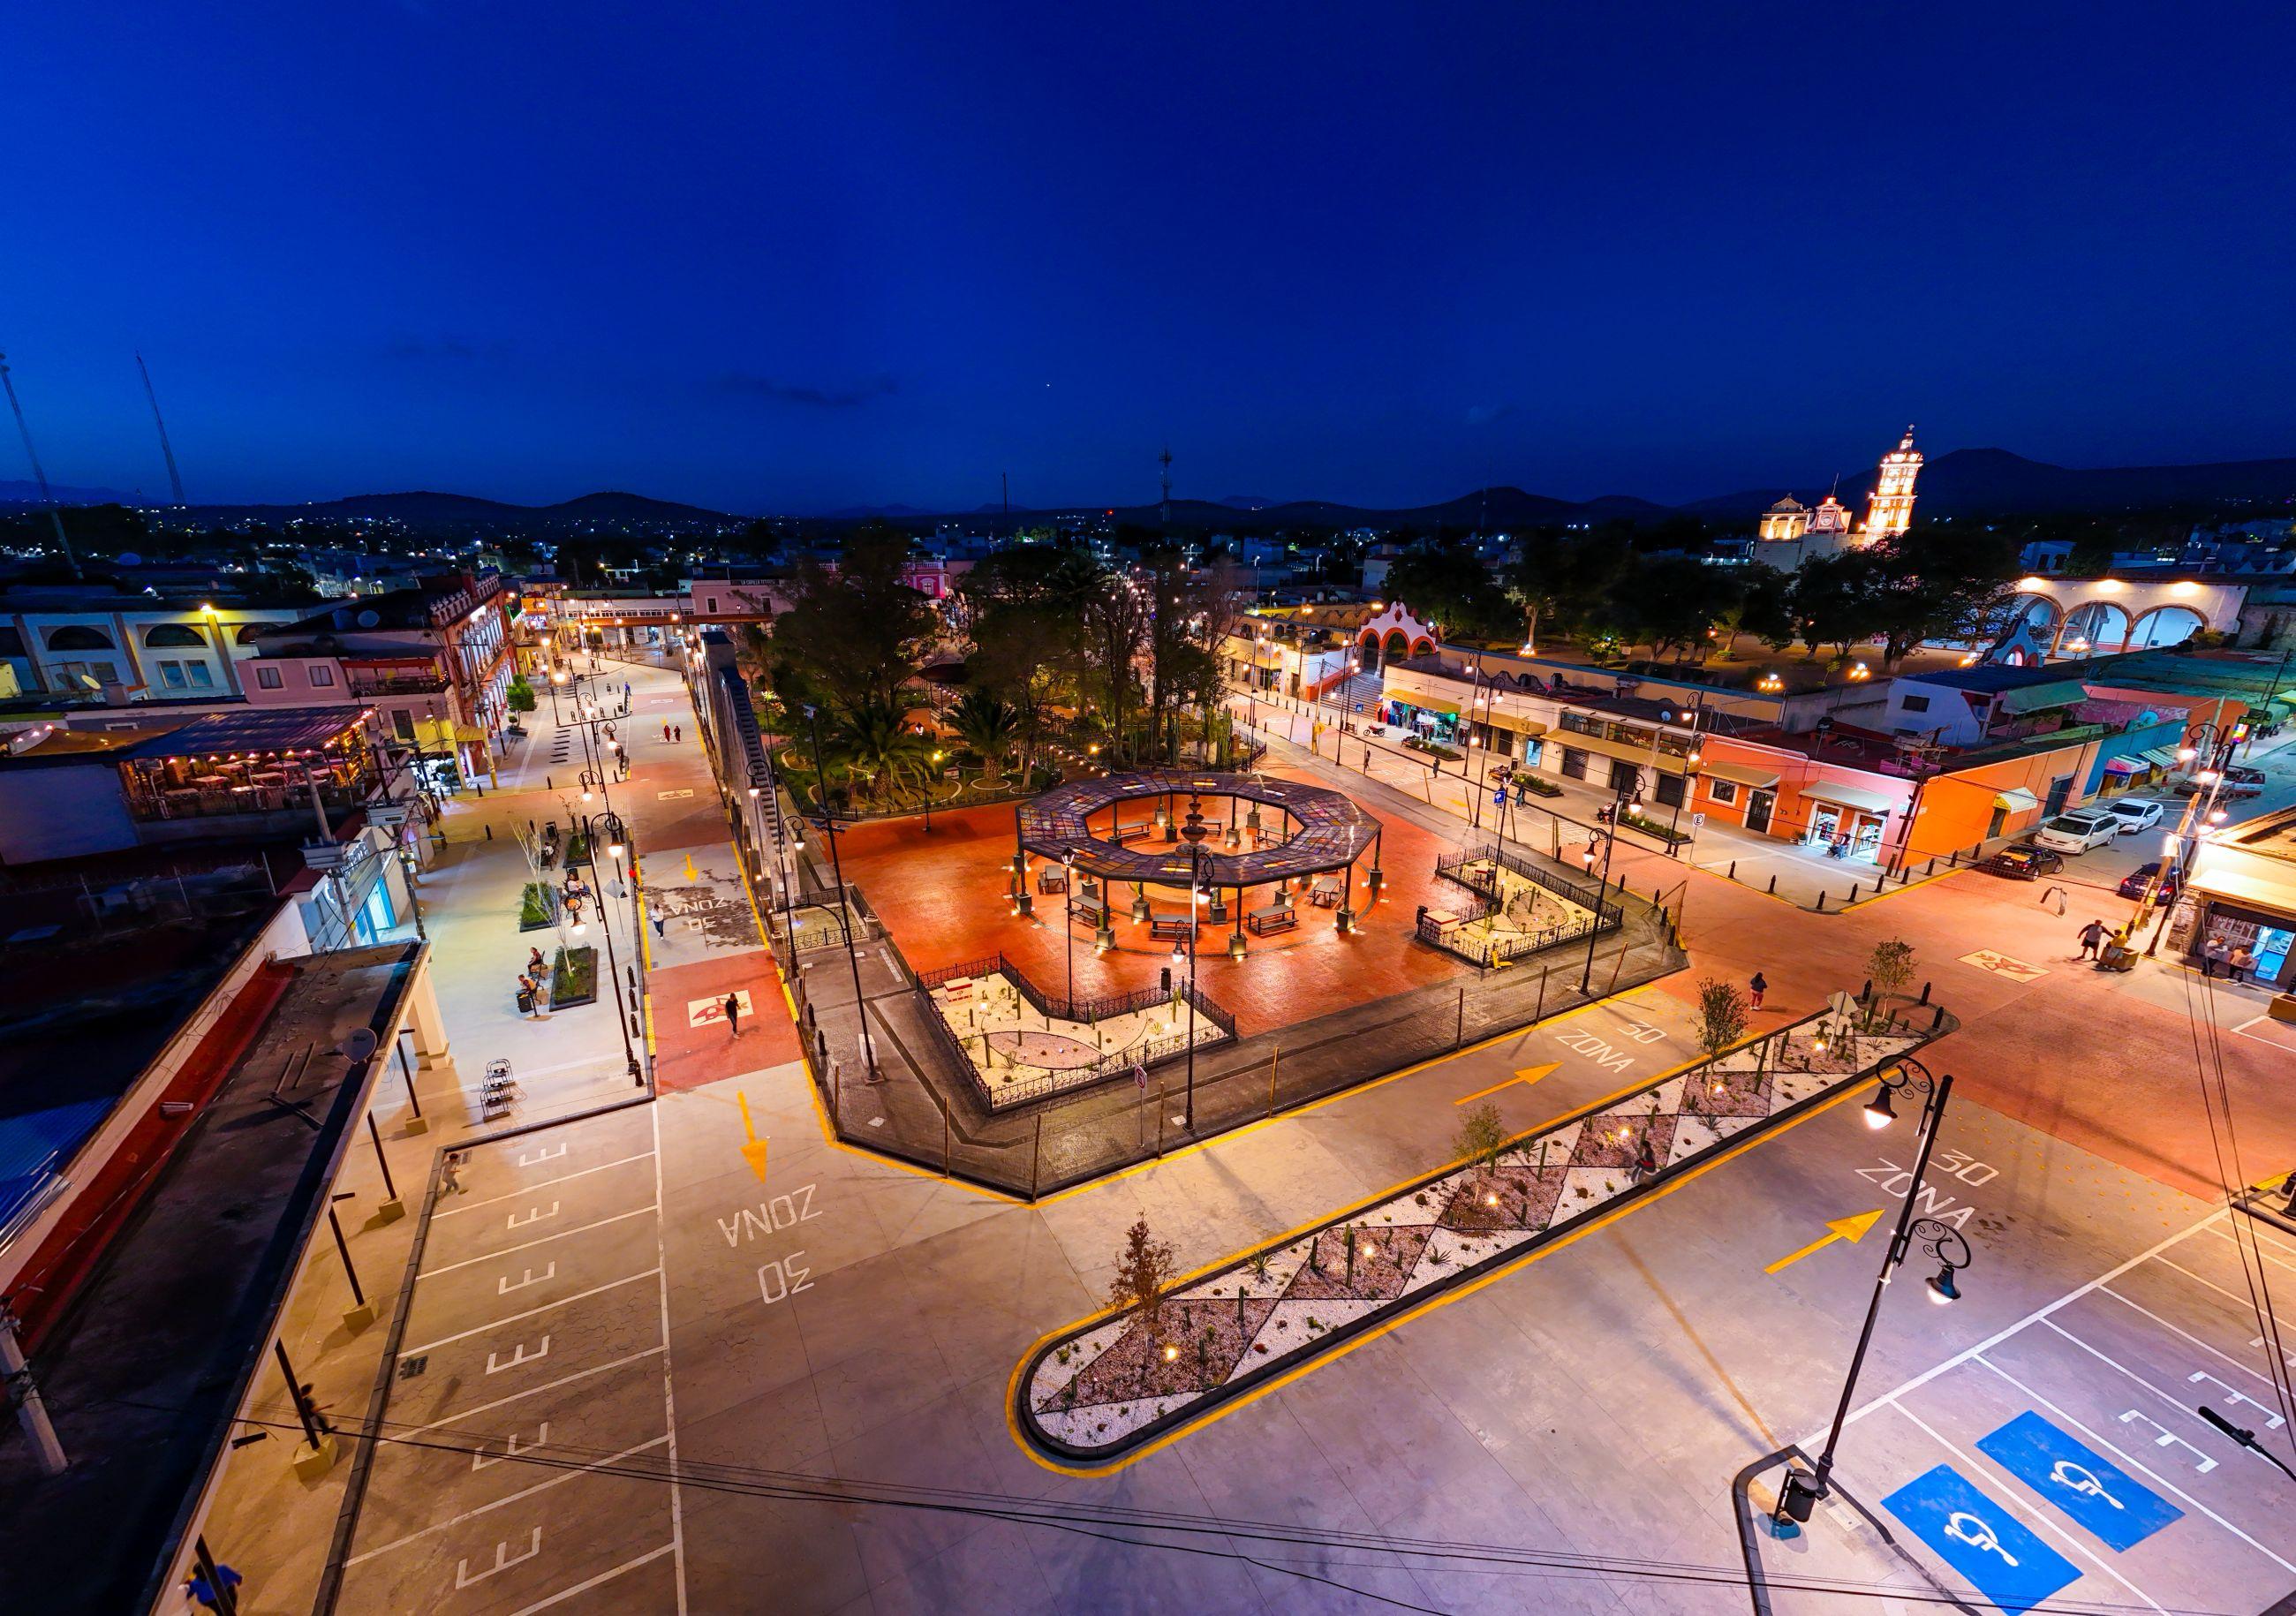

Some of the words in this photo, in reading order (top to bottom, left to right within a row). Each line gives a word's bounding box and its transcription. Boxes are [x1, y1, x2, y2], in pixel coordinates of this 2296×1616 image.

[670, 896, 729, 916] ZONA
[688, 916, 718, 931] 30
[1554, 1028, 1636, 1074] ZONA
[1616, 1020, 1668, 1045] 30
[518, 1143, 566, 1167] E
[1927, 1148, 2000, 1188] 30
[1854, 1157, 1975, 1231] ZONA
[507, 1201, 560, 1230] E
[716, 1183, 823, 1248] ZONA
[498, 1261, 555, 1295] E
[758, 1250, 815, 1304] 30
[486, 1335, 550, 1375] E
[2186, 1370, 2287, 1430] E
[2118, 1408, 2220, 1474] E
[455, 1526, 542, 1590] E
